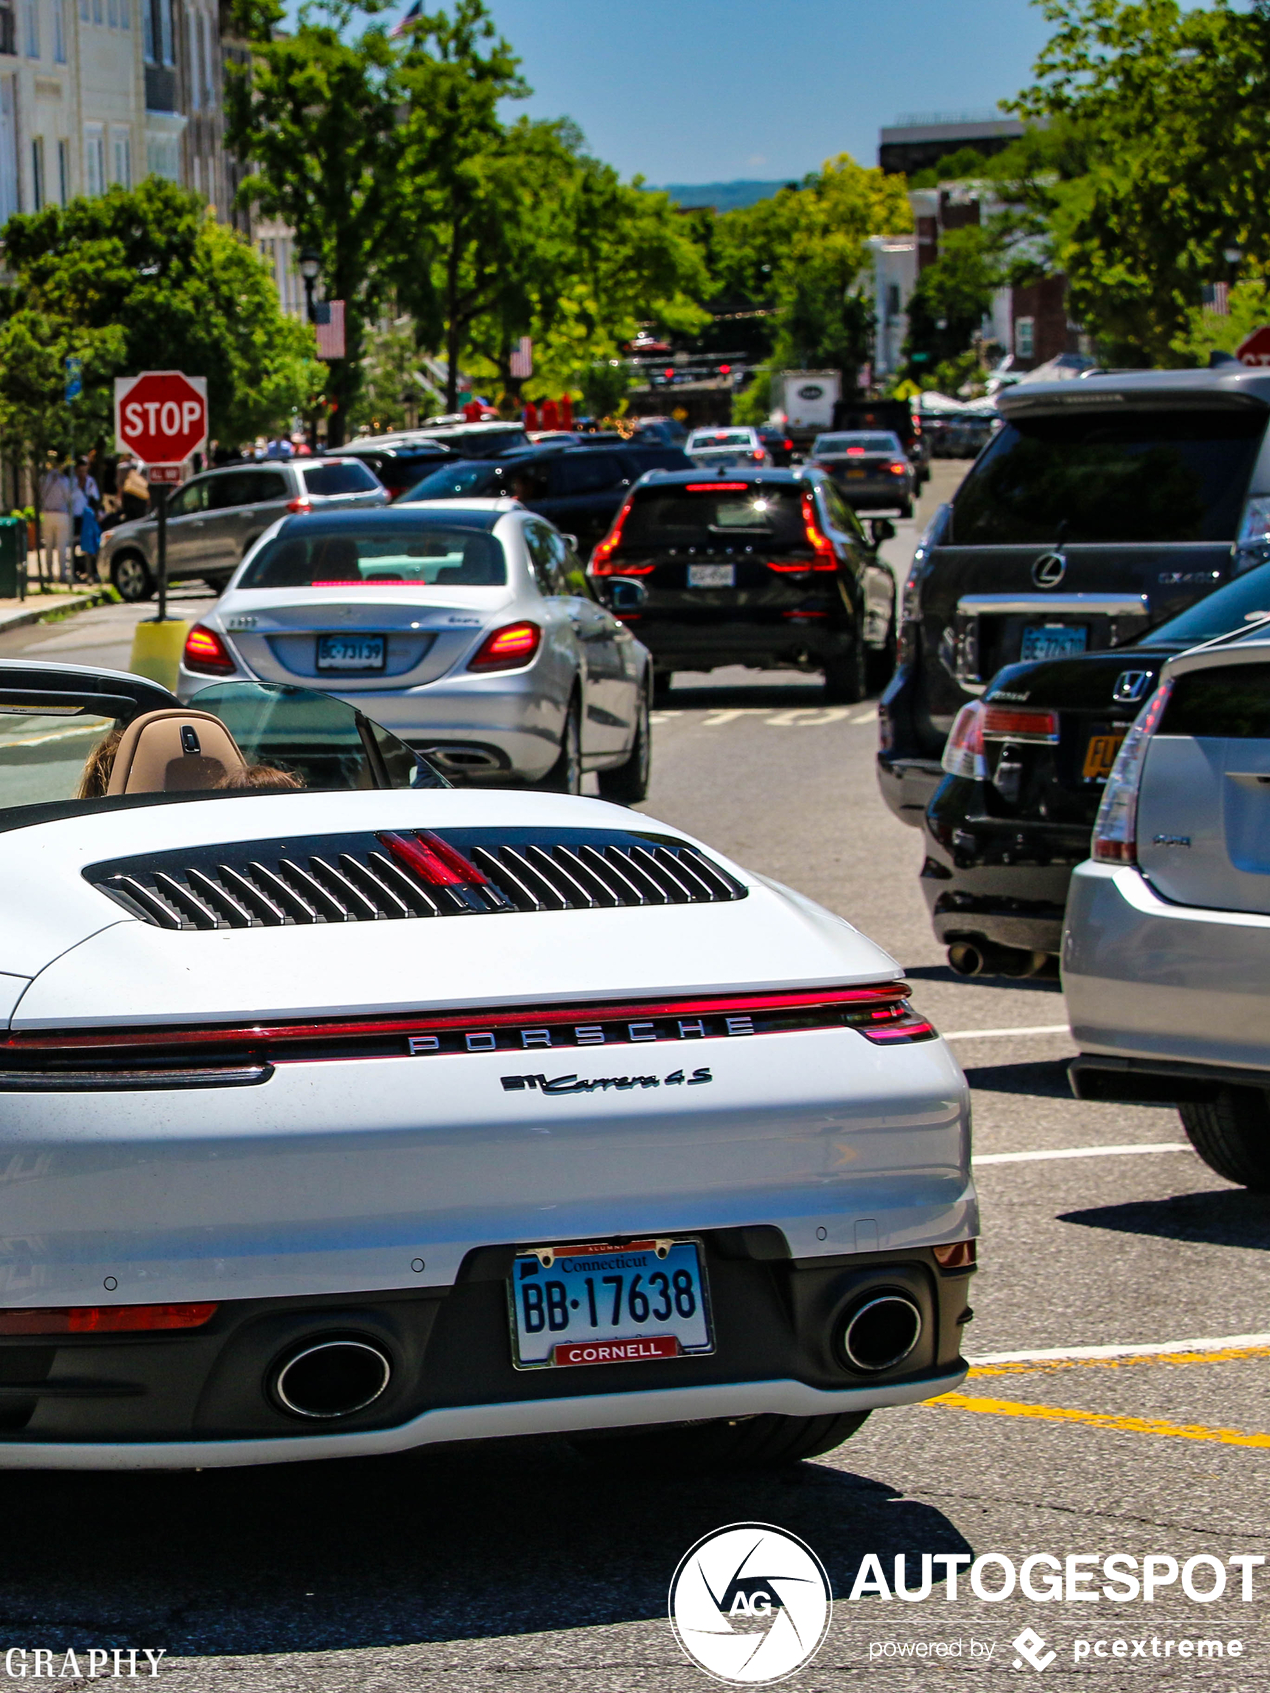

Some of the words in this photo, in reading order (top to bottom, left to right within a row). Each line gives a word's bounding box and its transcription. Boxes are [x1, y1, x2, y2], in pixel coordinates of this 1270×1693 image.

[124, 401, 201, 437] STOP
[408, 1016, 755, 1056] PORSCHE
[543, 1074, 660, 1095] Carrera
[561, 1255, 648, 1273] Connecticut
[568, 1342, 663, 1363] CORNELL
